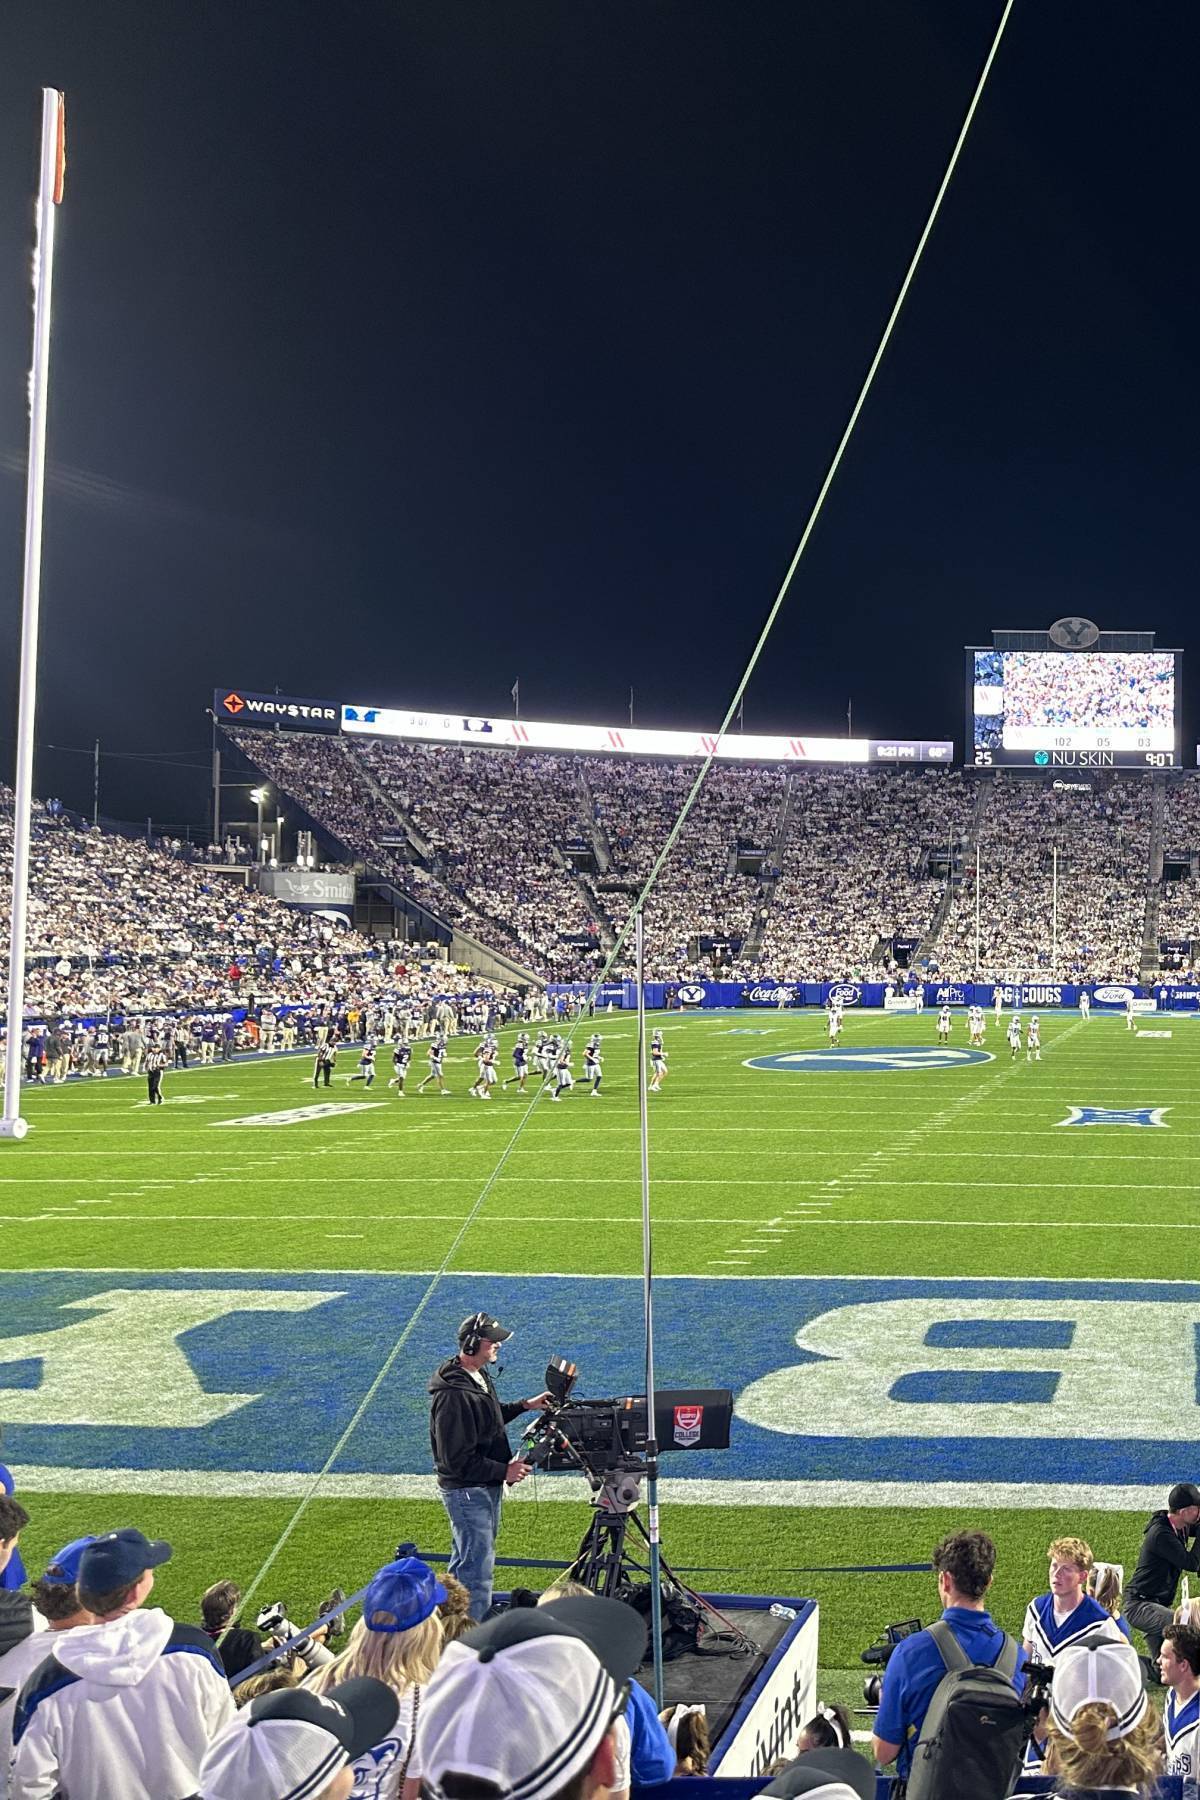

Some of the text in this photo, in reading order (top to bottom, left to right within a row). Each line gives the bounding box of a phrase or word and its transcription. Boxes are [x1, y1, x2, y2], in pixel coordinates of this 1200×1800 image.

[247, 700, 335, 719] WAYSTAR
[1055, 738, 1151, 747] 102 05 03
[974, 751, 992, 765] 25
[1052, 751, 1113, 766] NU SKIN
[1145, 752, 1174, 766] 9:07
[750, 986, 797, 1001] Coca-Cla
[835, 987, 854, 996] Food
[1022, 986, 1062, 1003] COUGS
[1102, 990, 1125, 999] Ford
